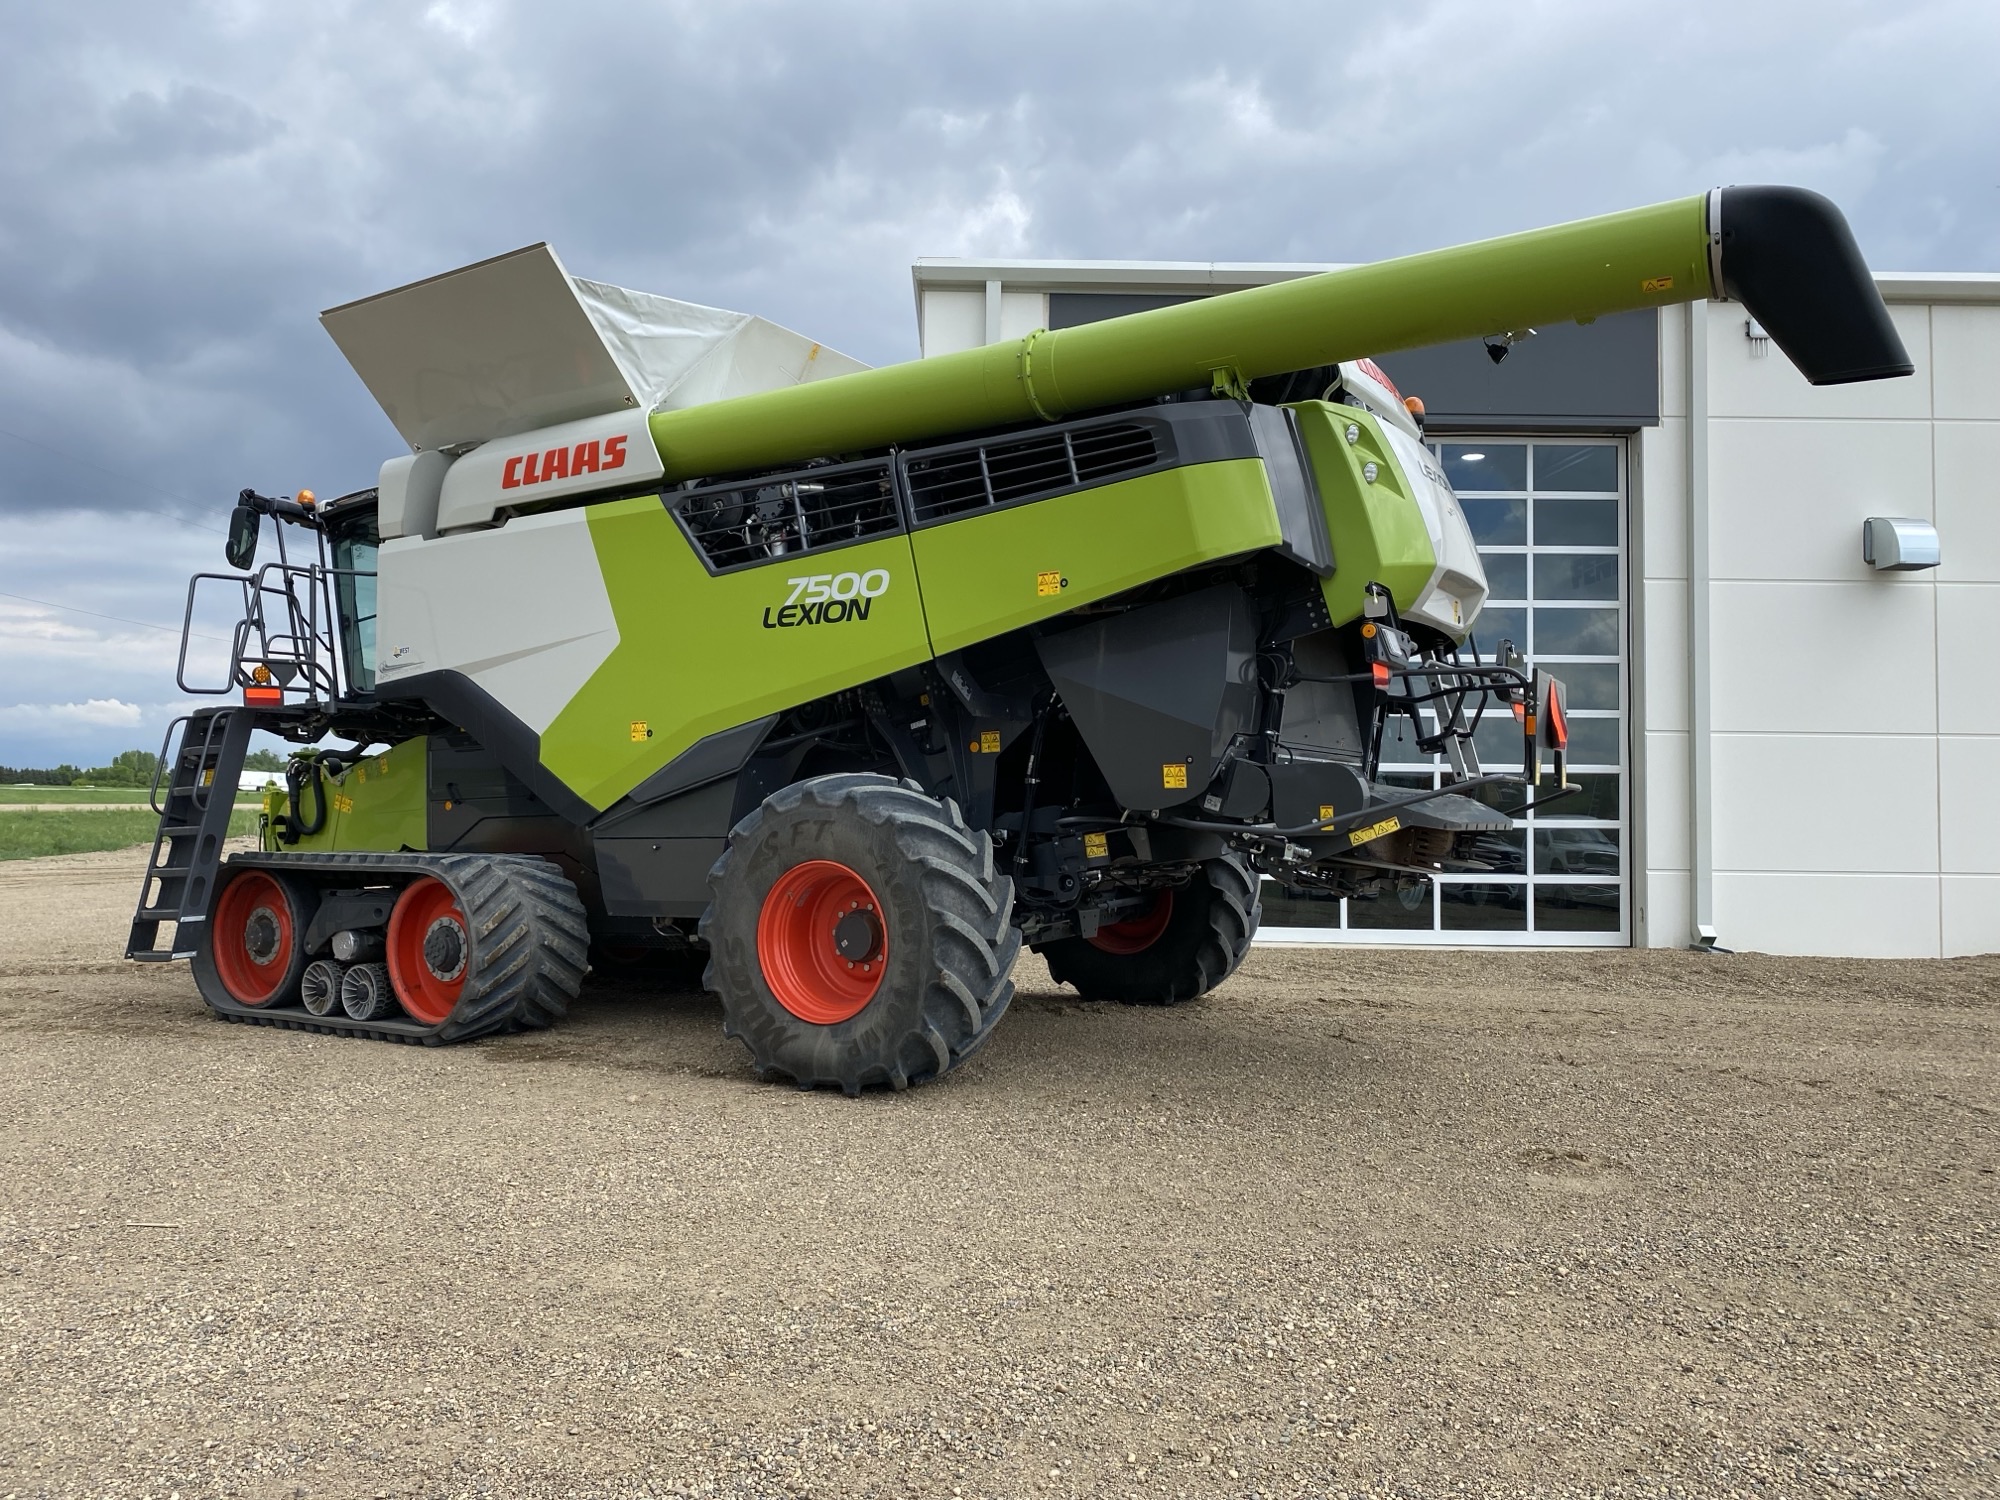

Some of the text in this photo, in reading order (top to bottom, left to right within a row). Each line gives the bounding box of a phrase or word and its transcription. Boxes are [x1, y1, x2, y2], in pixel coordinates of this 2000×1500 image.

[502, 435, 628, 489] CLAAS
[784, 569, 890, 606] 7500
[763, 597, 872, 628] LEXION
